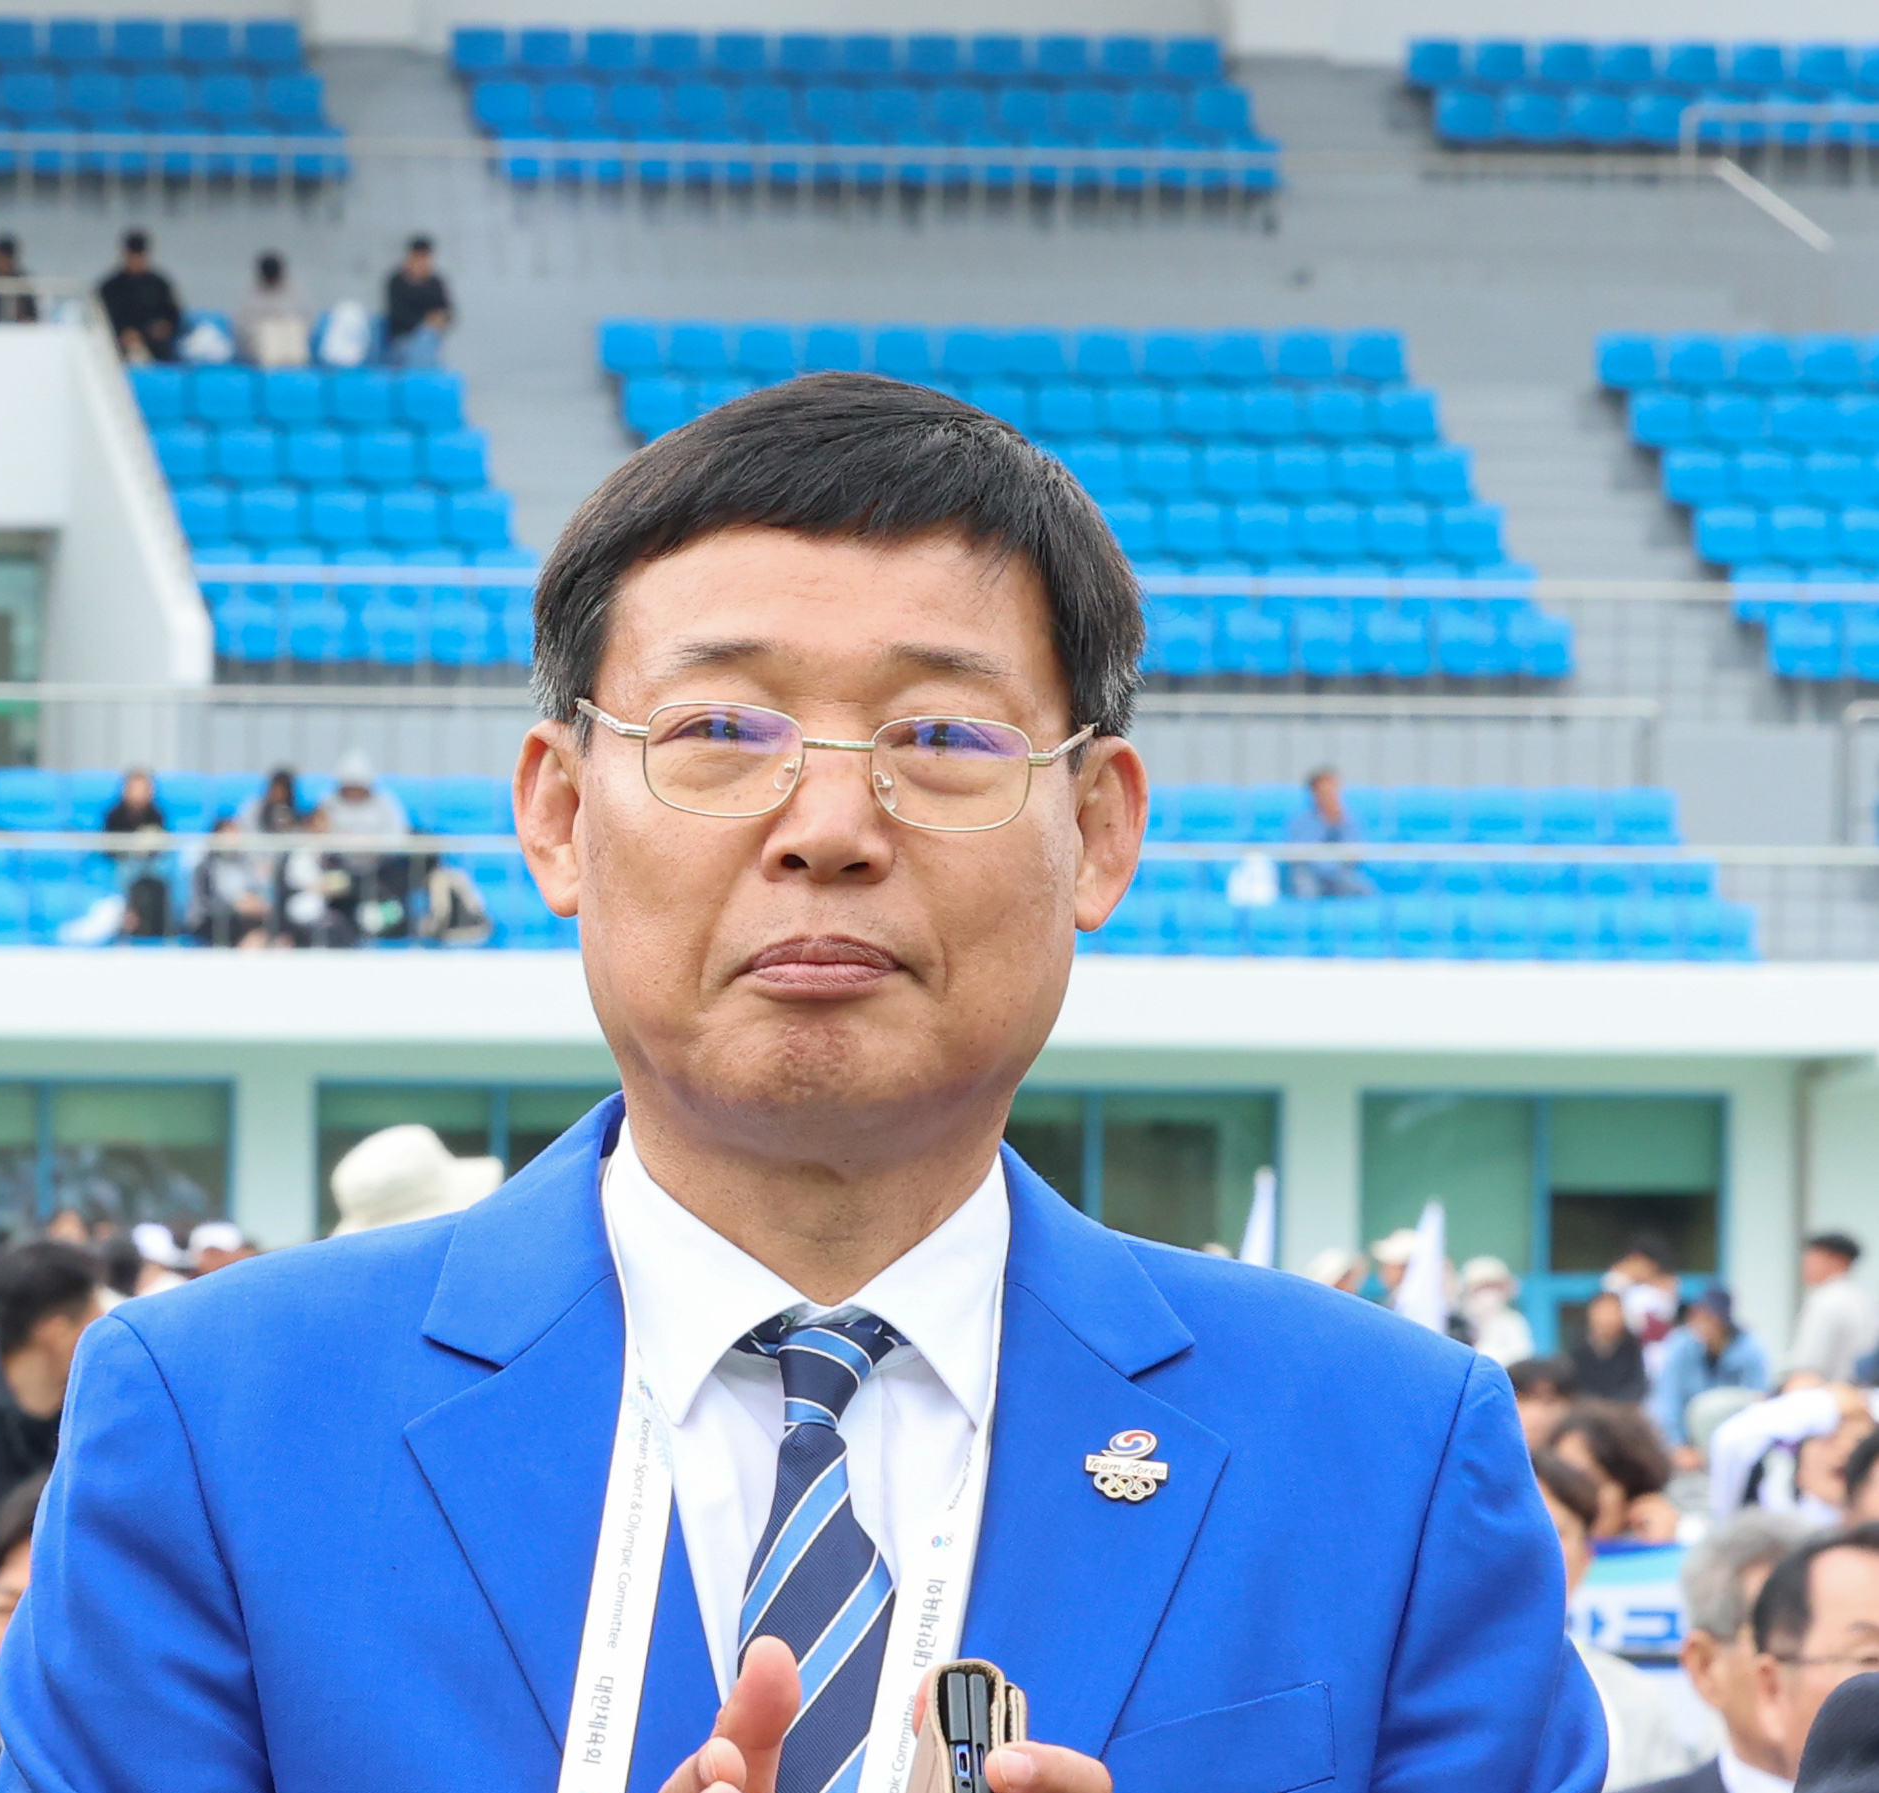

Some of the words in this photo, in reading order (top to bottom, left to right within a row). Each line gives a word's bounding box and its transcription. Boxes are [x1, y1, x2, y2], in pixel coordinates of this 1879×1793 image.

[638, 1418, 652, 1461] Korean
[1088, 1458, 1121, 1471] Team
[1124, 1462, 1165, 1477] Korea
[630, 1500, 643, 1511] &
[632, 1463, 649, 1500] Sport
[620, 1513, 641, 1569] Olympic
[607, 1572, 632, 1649] Committee
[913, 1578, 947, 1668] 대한체육회
[582, 1676, 614, 1765] 대한체육회
[891, 1694, 916, 1780] Committee
